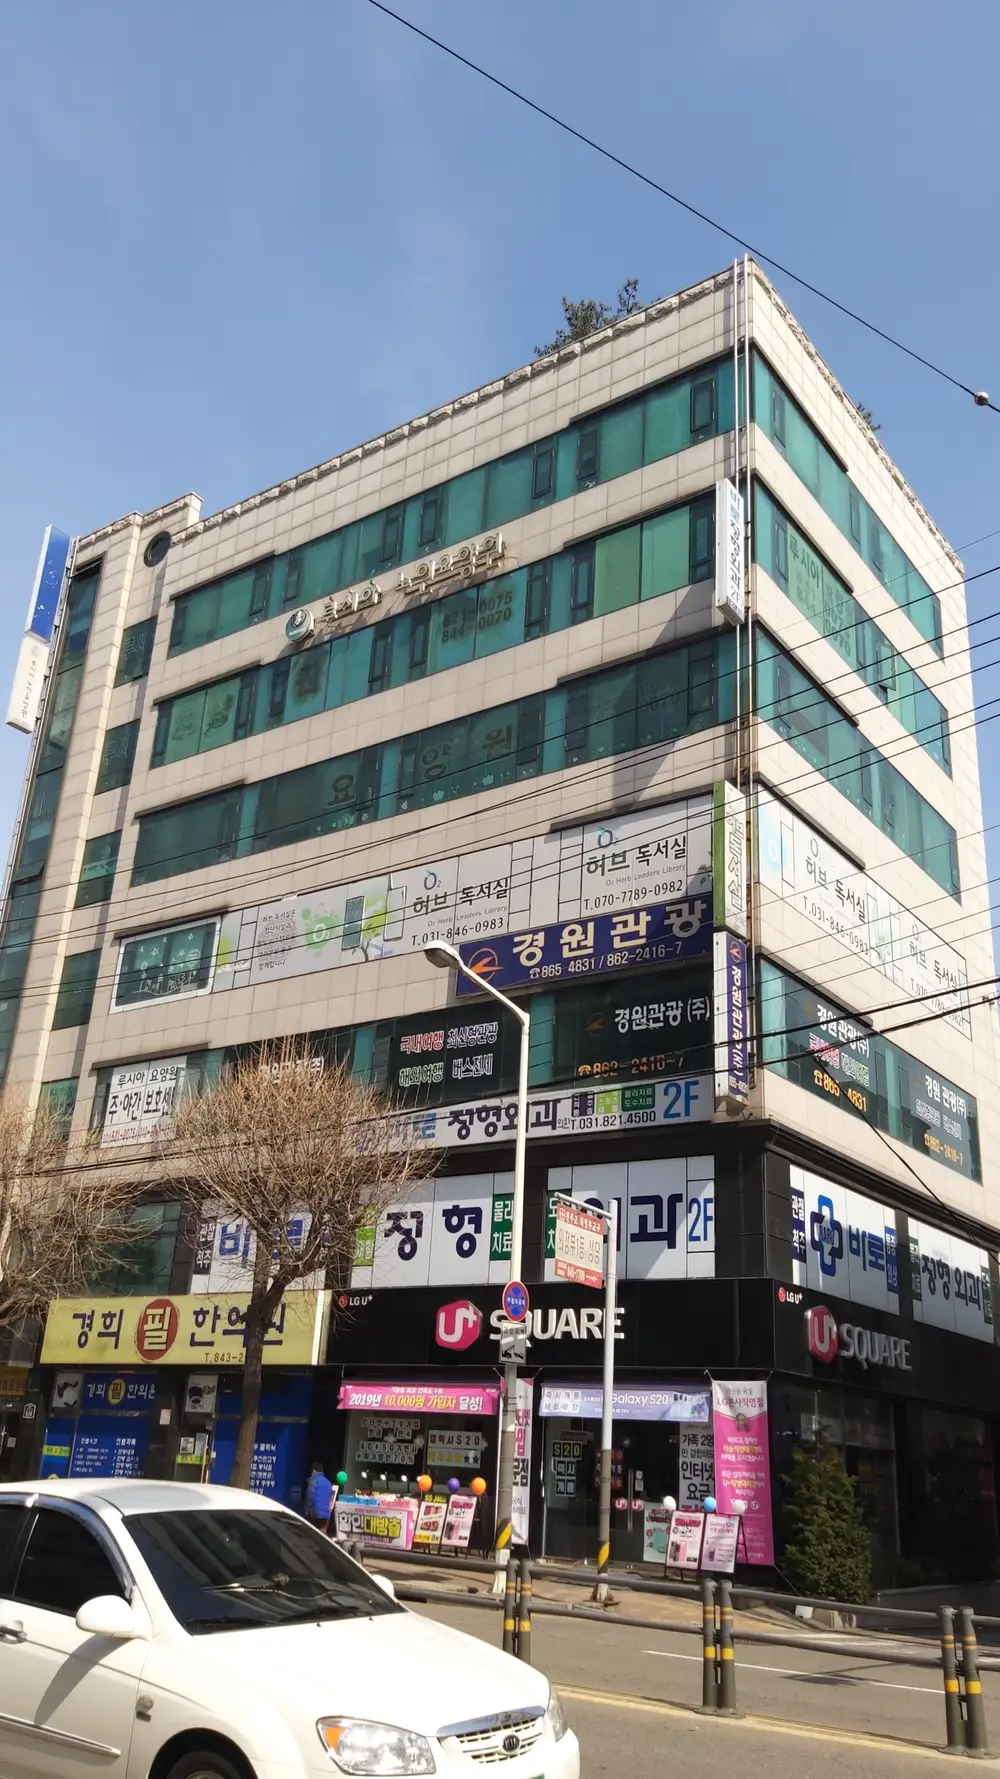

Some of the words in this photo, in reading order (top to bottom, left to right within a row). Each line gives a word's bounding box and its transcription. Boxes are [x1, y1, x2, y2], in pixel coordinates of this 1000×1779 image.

[585, 850, 630, 877] 허브
[635, 836, 686, 866] 독서실
[616, 874, 631, 885] Herb
[634, 870, 660, 881] Leaders
[662, 864, 686, 875] Library
[412, 892, 450, 915] 허브
[459, 877, 510, 906] 독서실
[805, 855, 828, 890] 허브
[834, 879, 867, 925] 독서실
[438, 917, 453, 925] Herb
[456, 911, 482, 922] Leaders
[484, 905, 508, 916] Library
[512, 900, 708, 967] 경원관광
[541, 964, 562, 978] 865
[568, 957, 595, 974] 4831
[614, 1000, 684, 1034] 경원관광
[400, 1031, 445, 1055] 국내여행
[446, 1021, 499, 1049] 최신형관광
[116, 1071, 145, 1089] 루시아
[149, 1066, 180, 1083] 요양원
[399, 1062, 444, 1087] 해외여행
[452, 1053, 494, 1080] 버스전세
[143, 1085, 178, 1117] 보호센
[663, 1080, 699, 1119] 2F
[570, 1110, 657, 1131] T.031.821.4500
[688, 1197, 714, 1242] 2F
[848, 1225, 885, 1272] 바로
[349, 1296, 360, 1306] LG
[72, 1308, 125, 1350] 경희
[143, 1306, 172, 1351] 필
[840, 1323, 913, 1371] SQUARE
[87, 1383, 106, 1399] 경희
[348, 1393, 383, 1407] 2019년
[384, 1395, 426, 1409] 10,000명
[427, 1395, 457, 1409] 가입자
[459, 1396, 484, 1411] 달성!
[611, 1393, 647, 1407] Galaxy
[649, 1394, 669, 1405] S20
[553, 1443, 581, 1458] S20
[682, 1434, 699, 1447] 가족
[681, 1461, 715, 1482] 인터넷
[686, 1483, 712, 1501] 요금
[338, 1511, 401, 1539] 할인대방출
